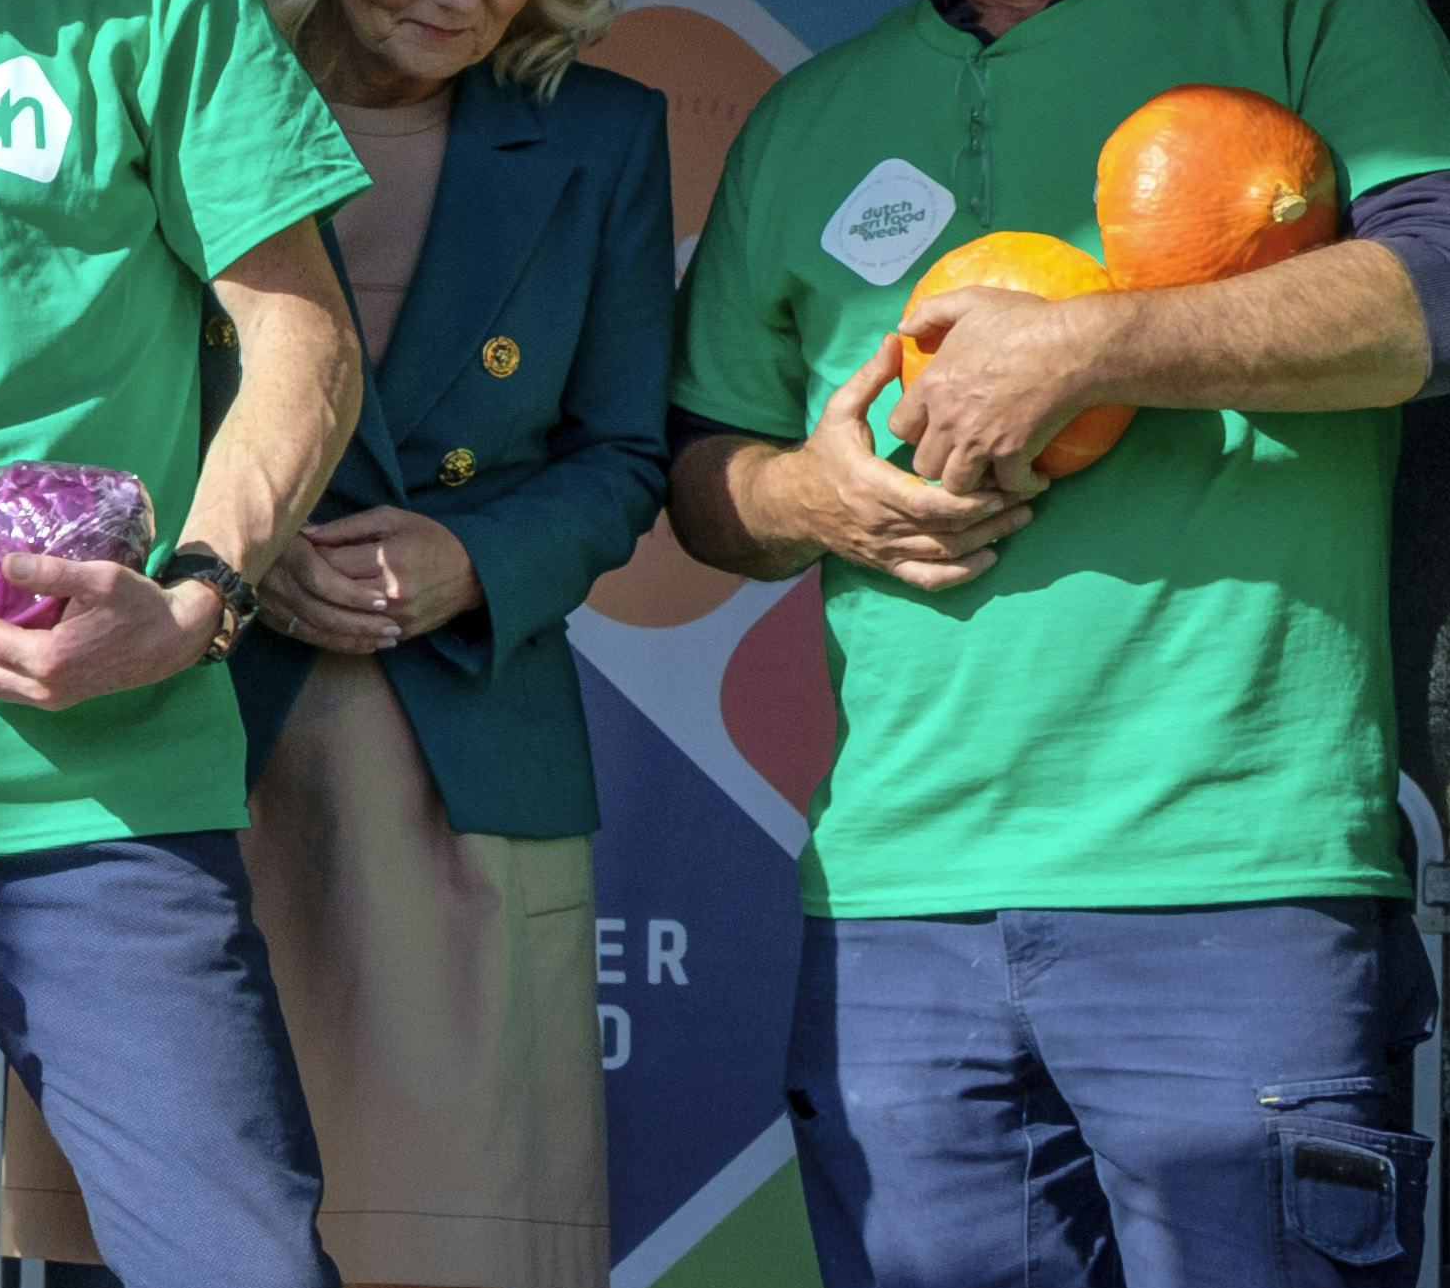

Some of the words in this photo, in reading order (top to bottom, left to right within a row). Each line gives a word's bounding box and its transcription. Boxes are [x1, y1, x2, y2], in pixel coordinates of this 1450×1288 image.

[861, 200, 913, 221] dutch
[883, 207, 926, 226] food
[862, 222, 910, 242] week
[595, 917, 690, 986] ER
